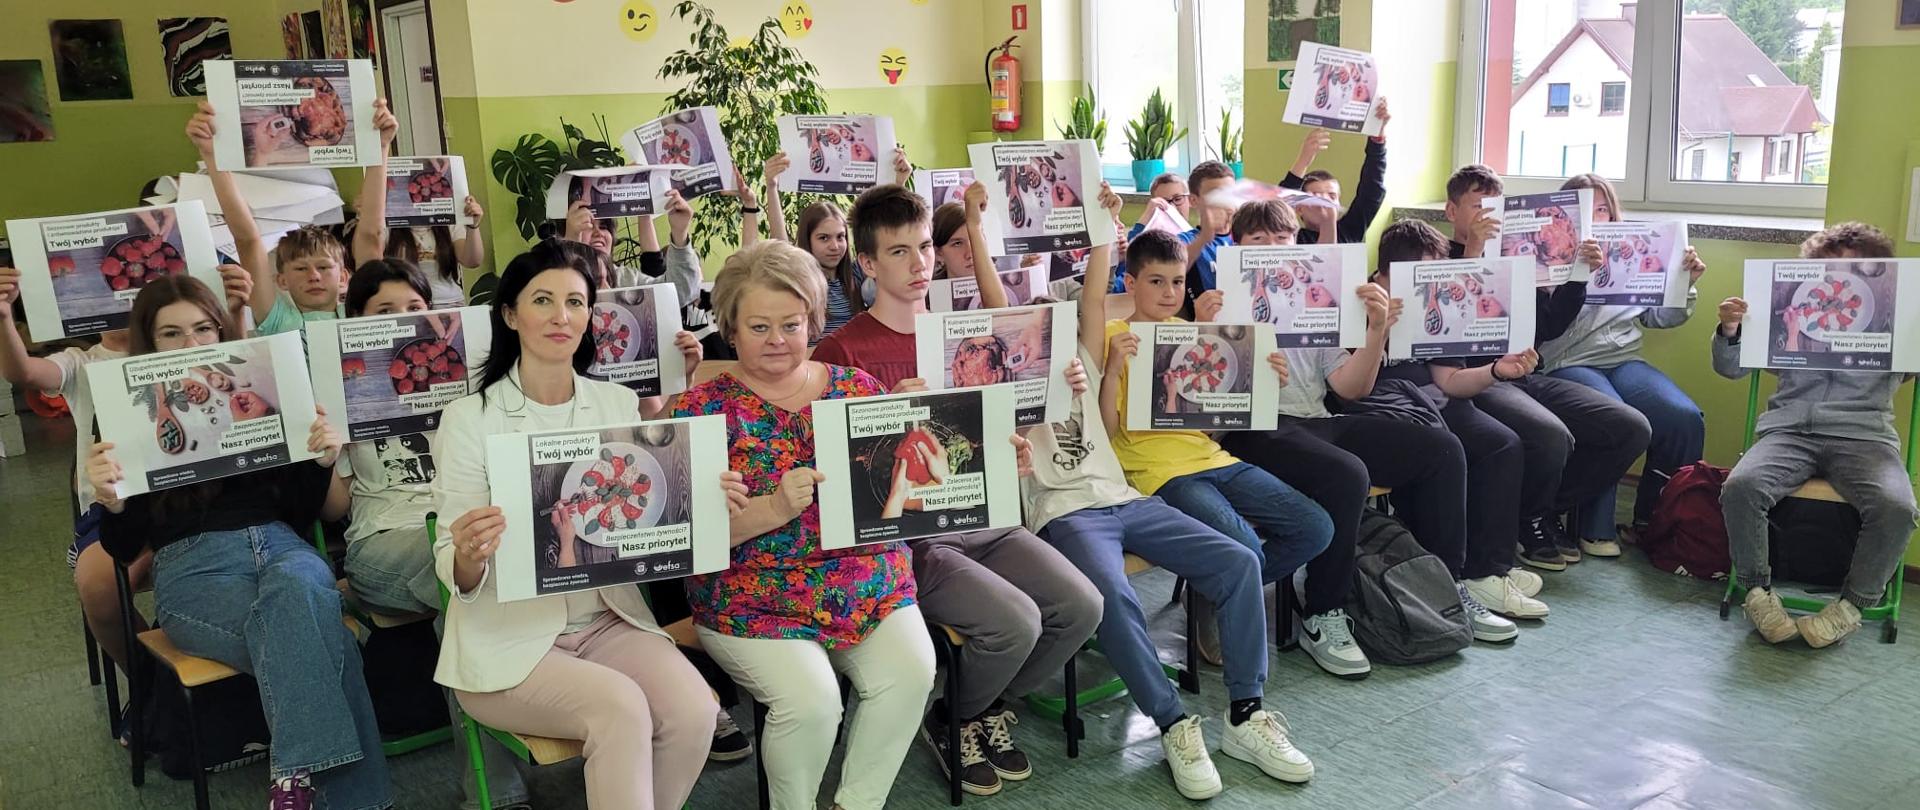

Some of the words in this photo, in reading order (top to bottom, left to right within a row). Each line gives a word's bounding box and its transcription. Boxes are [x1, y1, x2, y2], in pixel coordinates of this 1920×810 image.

[241, 82, 271, 91] priorytet
[313, 147, 335, 155] wybór
[335, 146, 353, 155] Twój
[998, 156, 1012, 165] Twój
[1012, 155, 1028, 163] wybór
[1059, 221, 1084, 231] priorytet
[49, 239, 72, 249] Twój
[72, 237, 100, 248] wybór
[1261, 258, 1280, 266] wybór
[1418, 273, 1432, 281] Twój
[1778, 272, 1796, 281] Twój
[1797, 272, 1820, 280] wybór
[955, 289, 968, 297] Twój
[1309, 321, 1337, 330] priorytet
[948, 327, 965, 337] Twój
[966, 326, 988, 335] wybór
[344, 339, 365, 351] Twój
[366, 337, 389, 349] wybór
[1159, 335, 1174, 343] Twój
[1855, 341, 1889, 350] priorytet
[131, 372, 155, 384] Twój
[156, 368, 184, 380] wybór
[611, 371, 627, 380] Nasz
[628, 368, 656, 379] priorytet
[414, 401, 433, 410] Nasz
[1016, 395, 1044, 406] priorytet
[1222, 402, 1249, 410] priorytet
[851, 407, 881, 415] Sezonowe
[882, 403, 905, 414] produkty
[855, 411, 896, 422] zrównoważona
[896, 408, 928, 419] produkcja?
[852, 422, 875, 434] Twój
[876, 421, 901, 433] wybór
[221, 440, 243, 451] Nasz
[244, 432, 281, 447] priorytet
[535, 438, 562, 448] Lokalne
[562, 435, 596, 446] produkty?
[536, 449, 562, 461] Twój
[563, 447, 595, 460] wybór
[946, 476, 971, 485] Zalecenia
[914, 485, 945, 497] postępować
[951, 481, 983, 493] żywnością?
[925, 494, 947, 507] Nasz
[948, 491, 983, 506] priorytet
[961, 514, 977, 524] efsa
[605, 530, 655, 543] Bezpieczeństwo
[656, 526, 688, 538] żywności?
[621, 541, 646, 552] Nasz
[647, 536, 688, 552] priorytet
[661, 560, 680, 571] efsa
